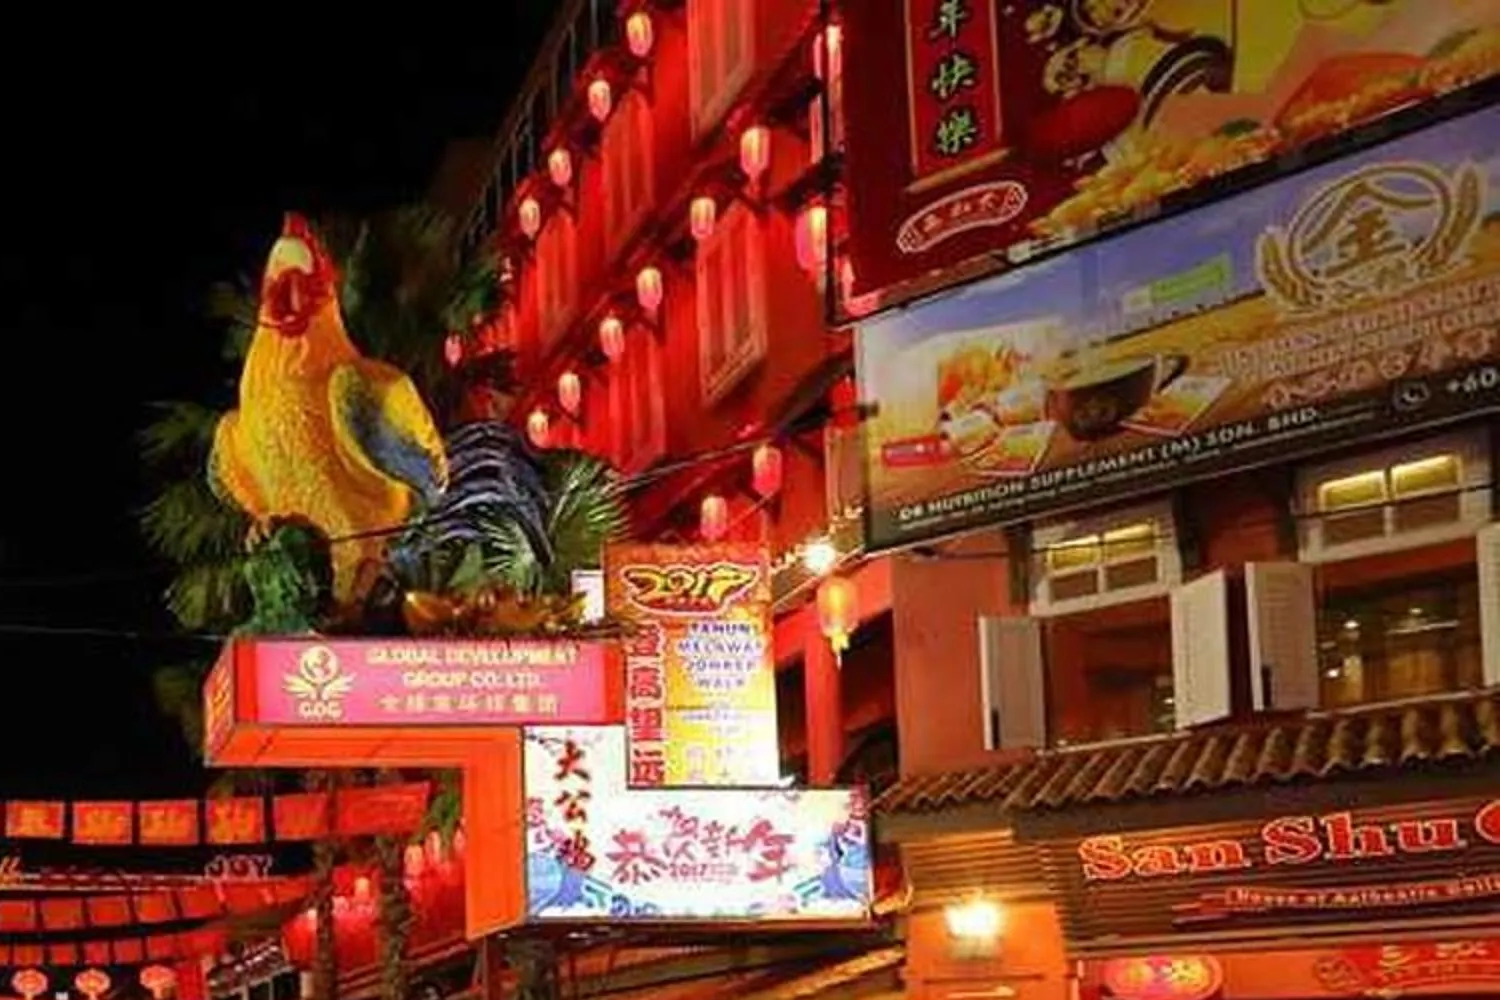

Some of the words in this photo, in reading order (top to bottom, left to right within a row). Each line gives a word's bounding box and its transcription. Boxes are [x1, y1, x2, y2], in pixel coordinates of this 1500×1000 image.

[1030, 446, 1157, 488] SUPPLEMENT
[624, 563, 758, 603] 2017
[403, 671, 467, 687] GROUP
[1078, 834, 1252, 881] San
[1262, 810, 1469, 865] Shu
